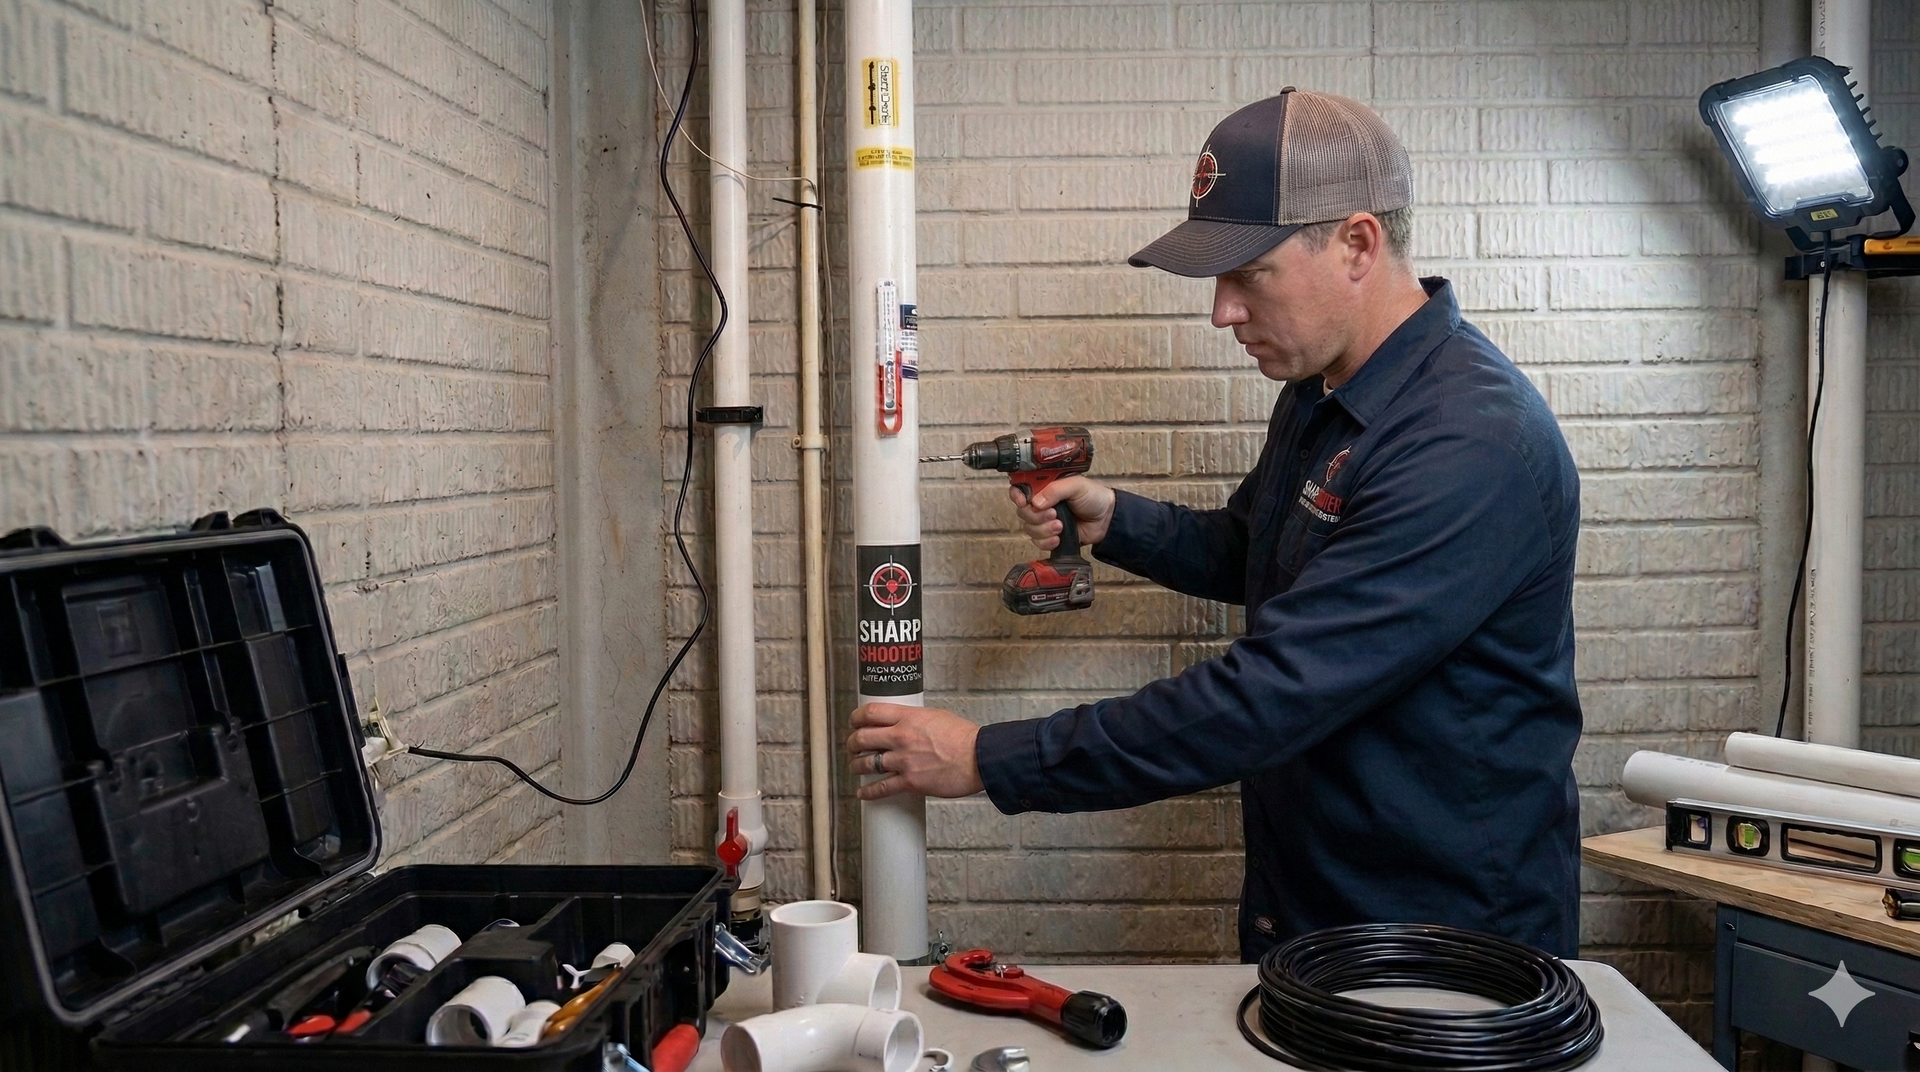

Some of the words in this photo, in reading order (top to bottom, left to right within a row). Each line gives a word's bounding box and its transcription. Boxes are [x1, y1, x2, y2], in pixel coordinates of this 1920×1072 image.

[859, 618, 921, 643] SHARP
[860, 644, 922, 662] SHOOTER
[890, 664, 917, 673] RADON
